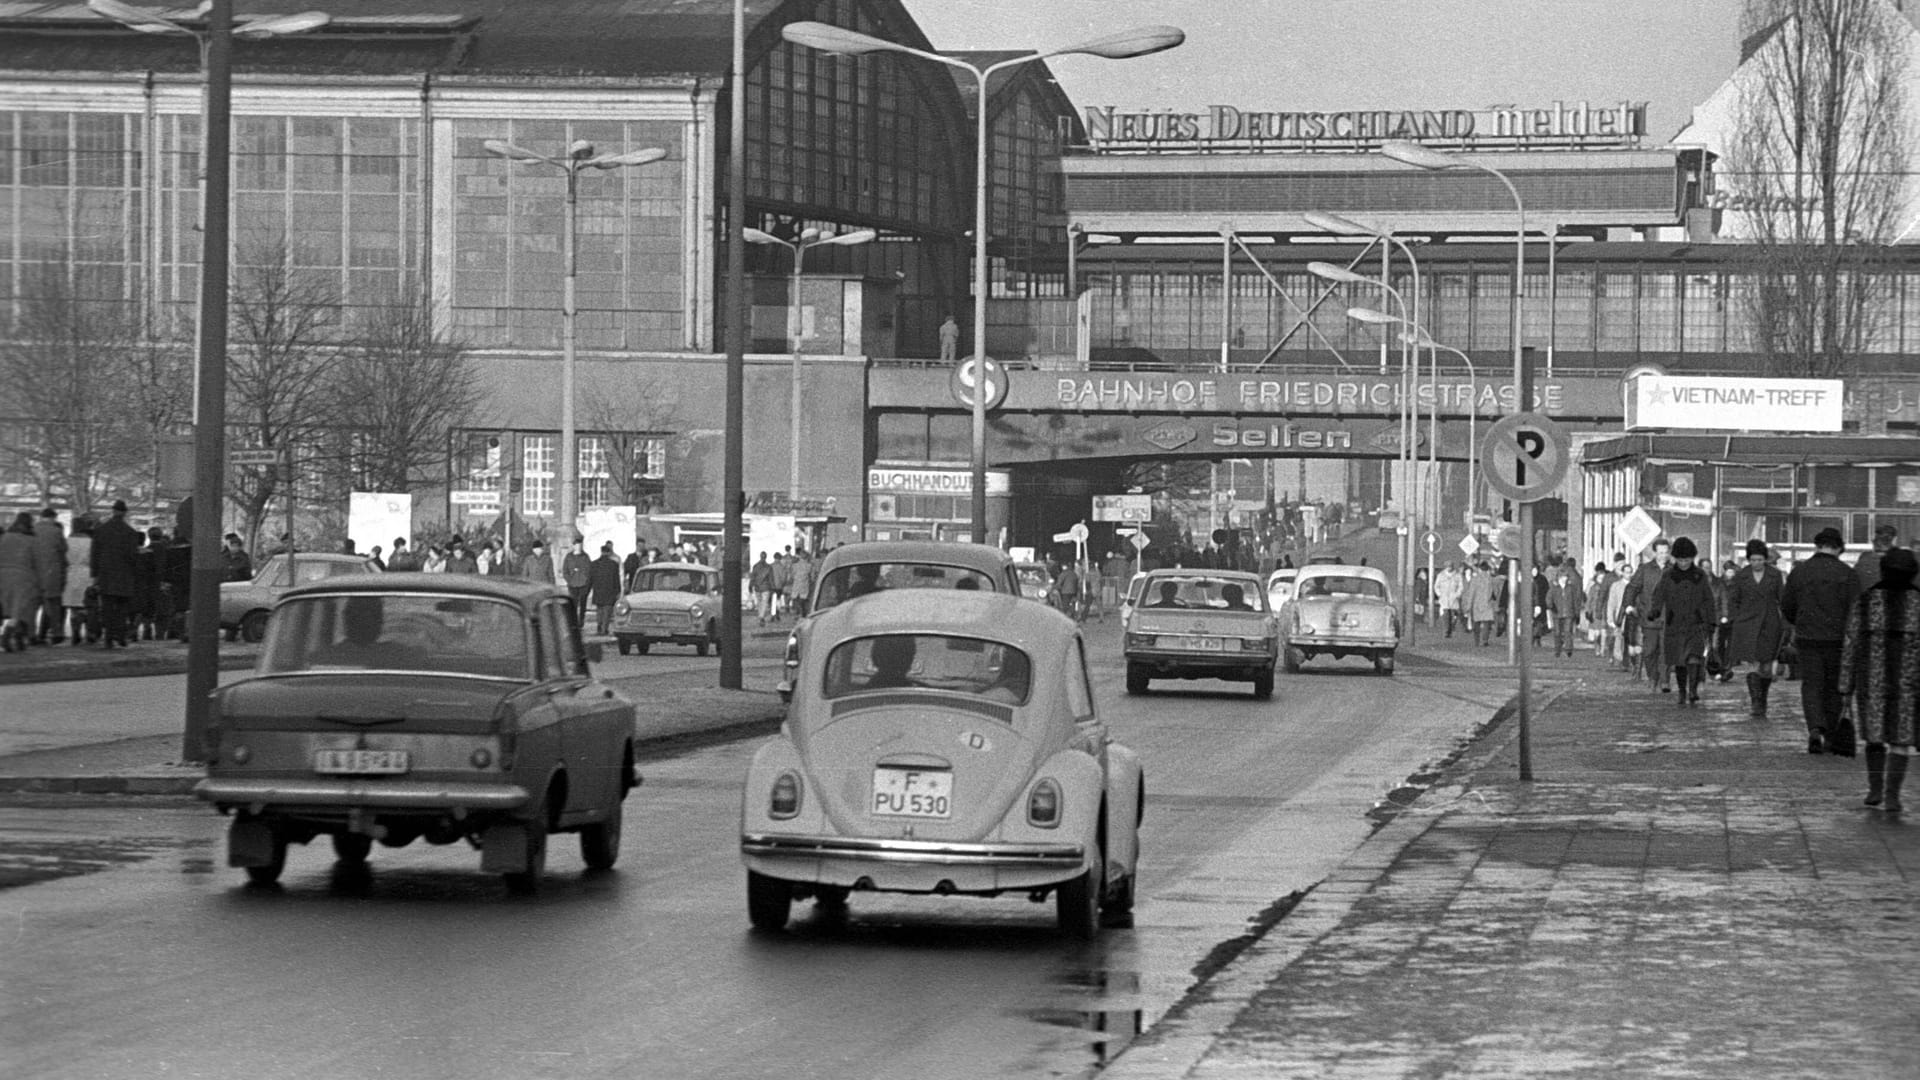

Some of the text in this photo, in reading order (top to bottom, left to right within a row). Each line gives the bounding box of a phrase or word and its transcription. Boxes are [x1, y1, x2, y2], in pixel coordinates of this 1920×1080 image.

[1207, 104, 1476, 140] DEUTSCHLAND
[958, 359, 996, 405] S
[1057, 378, 1217, 404] BAHNHOF
[1672, 386, 1828, 407] VIETNAM-TREFF
[1516, 430, 1545, 486] P
[968, 732, 985, 750] D
[904, 771, 920, 791] F
[874, 792, 949, 815] PU 530
